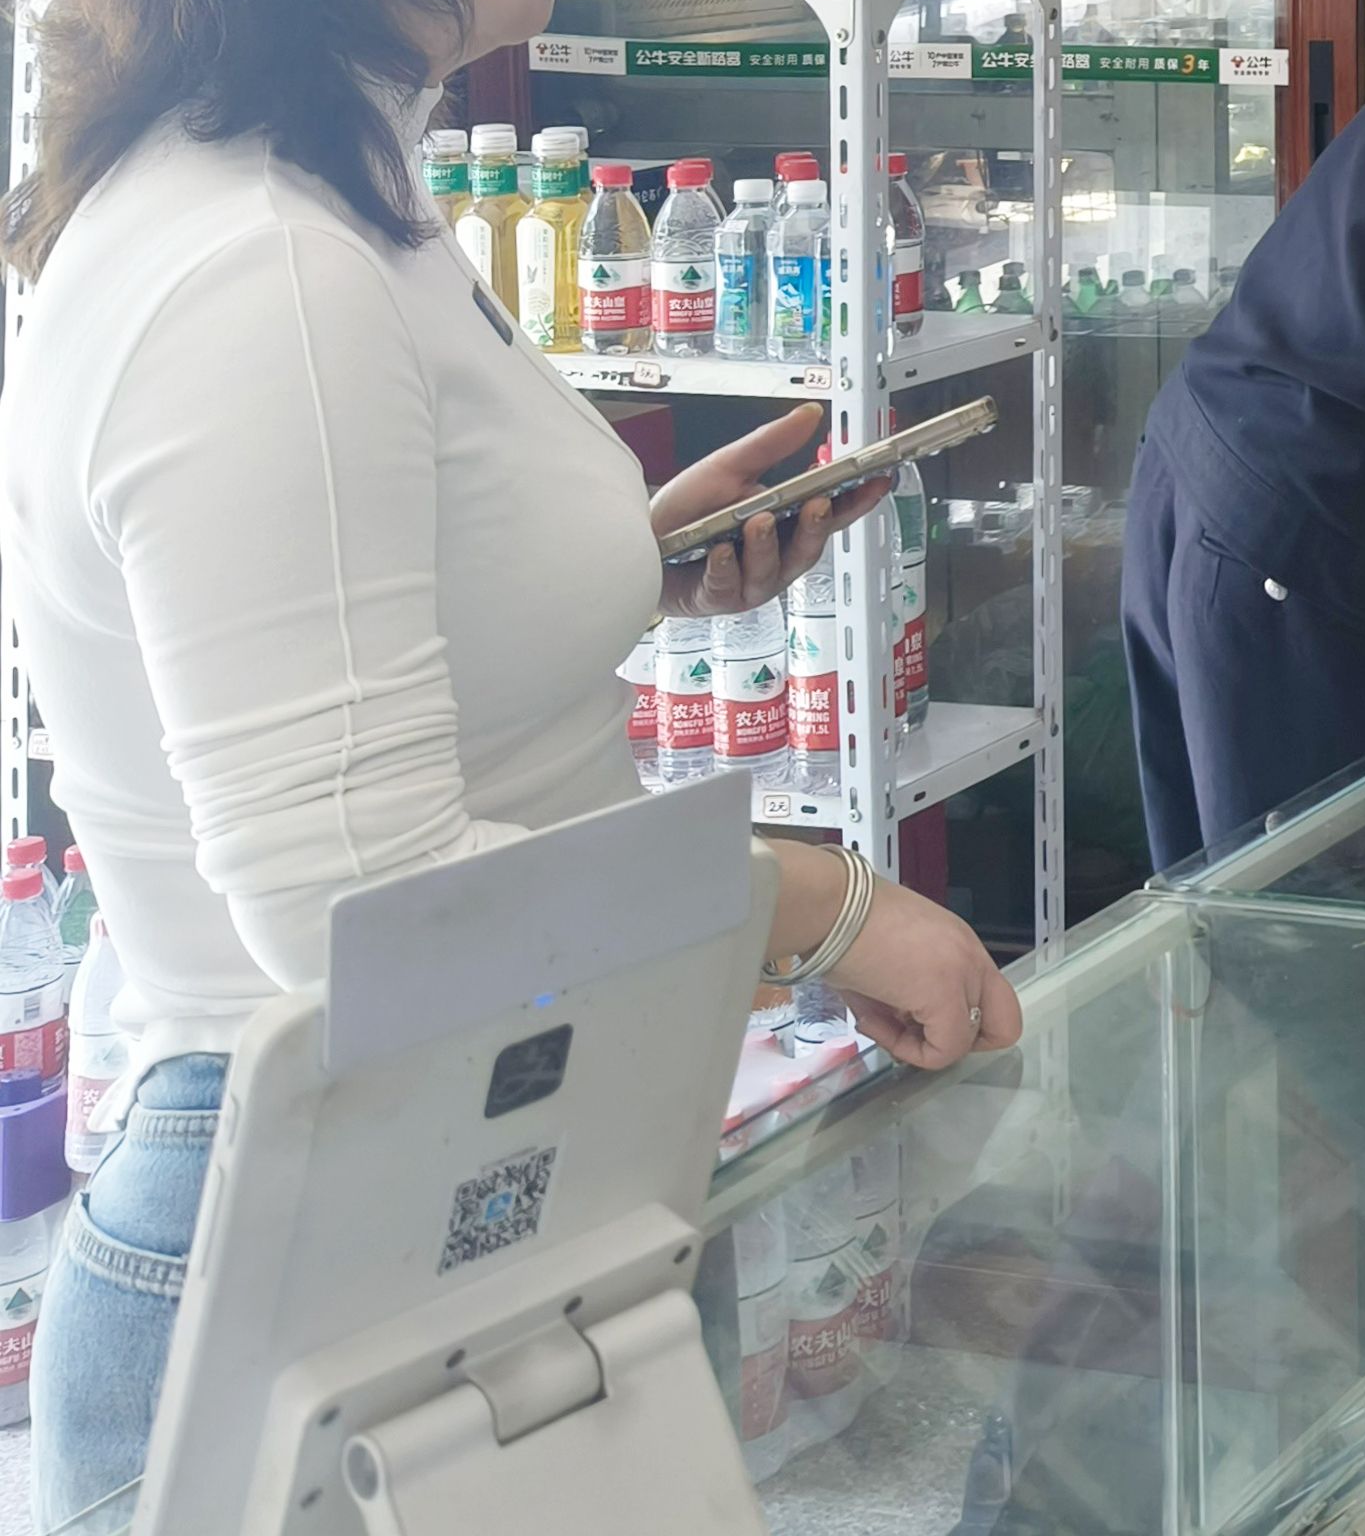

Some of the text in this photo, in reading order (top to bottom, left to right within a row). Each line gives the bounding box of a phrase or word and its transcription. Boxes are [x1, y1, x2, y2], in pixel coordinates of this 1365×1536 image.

[550, 43, 572, 56] 公牛
[635, 50, 826, 66] 公牛安全断路器 安全耐用 质保
[889, 51, 914, 63] 公牛
[1100, 57, 1149, 70] 安全耐用
[1247, 56, 1272, 69] 公牛
[669, 297, 714, 310] 农夫山泉
[768, 801, 788, 812] 2元
